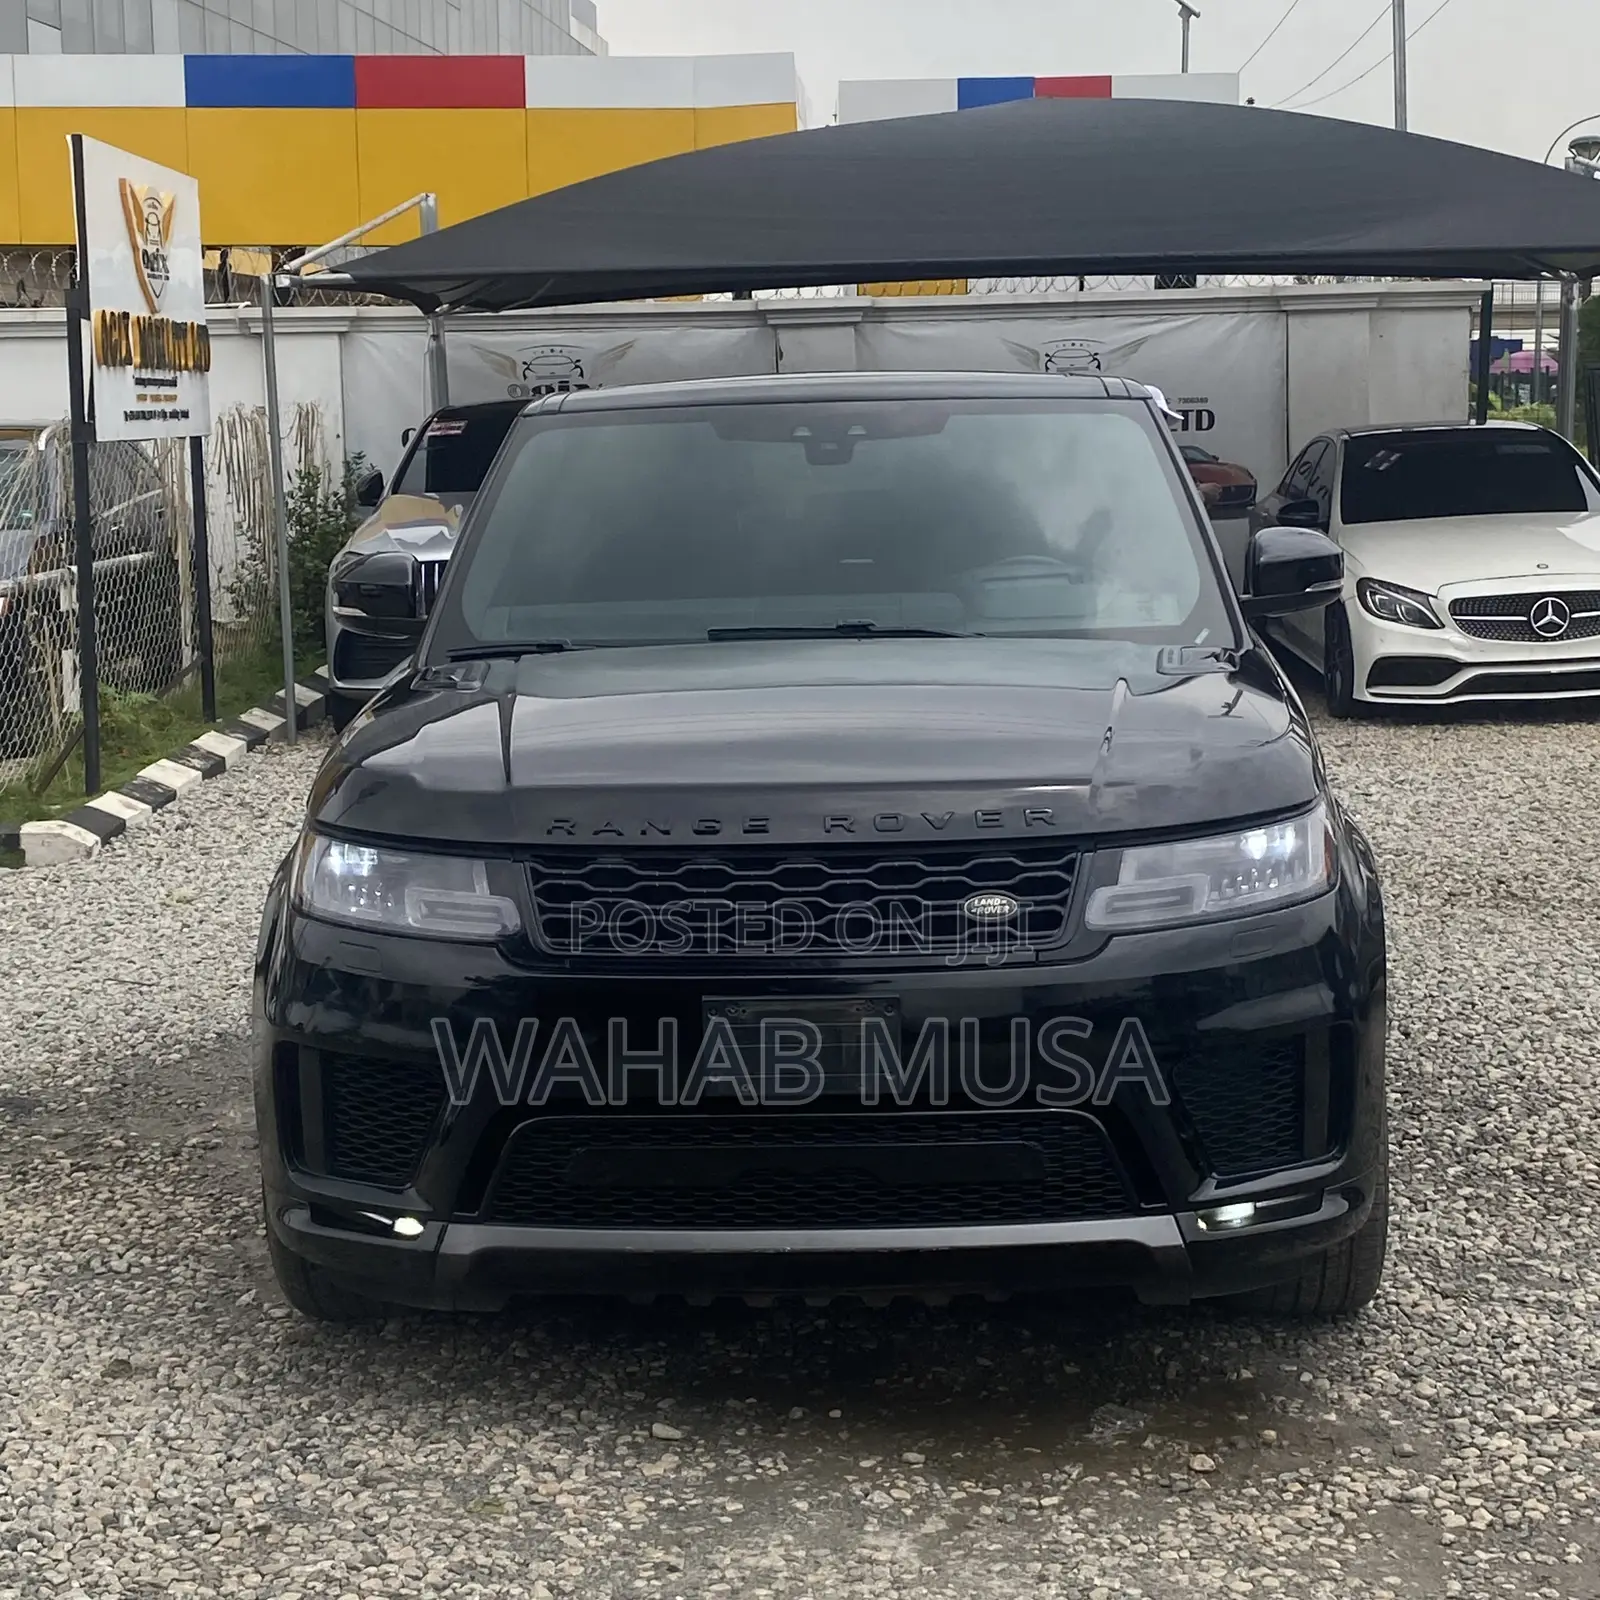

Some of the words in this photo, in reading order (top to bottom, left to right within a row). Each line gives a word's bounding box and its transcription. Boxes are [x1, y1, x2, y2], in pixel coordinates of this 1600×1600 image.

[1170, 409, 1215, 432] TD
[546, 816, 771, 837] RANGE
[823, 808, 1056, 834] ROVER
[974, 897, 1001, 907] LAND
[976, 904, 1010, 915] ROVER
